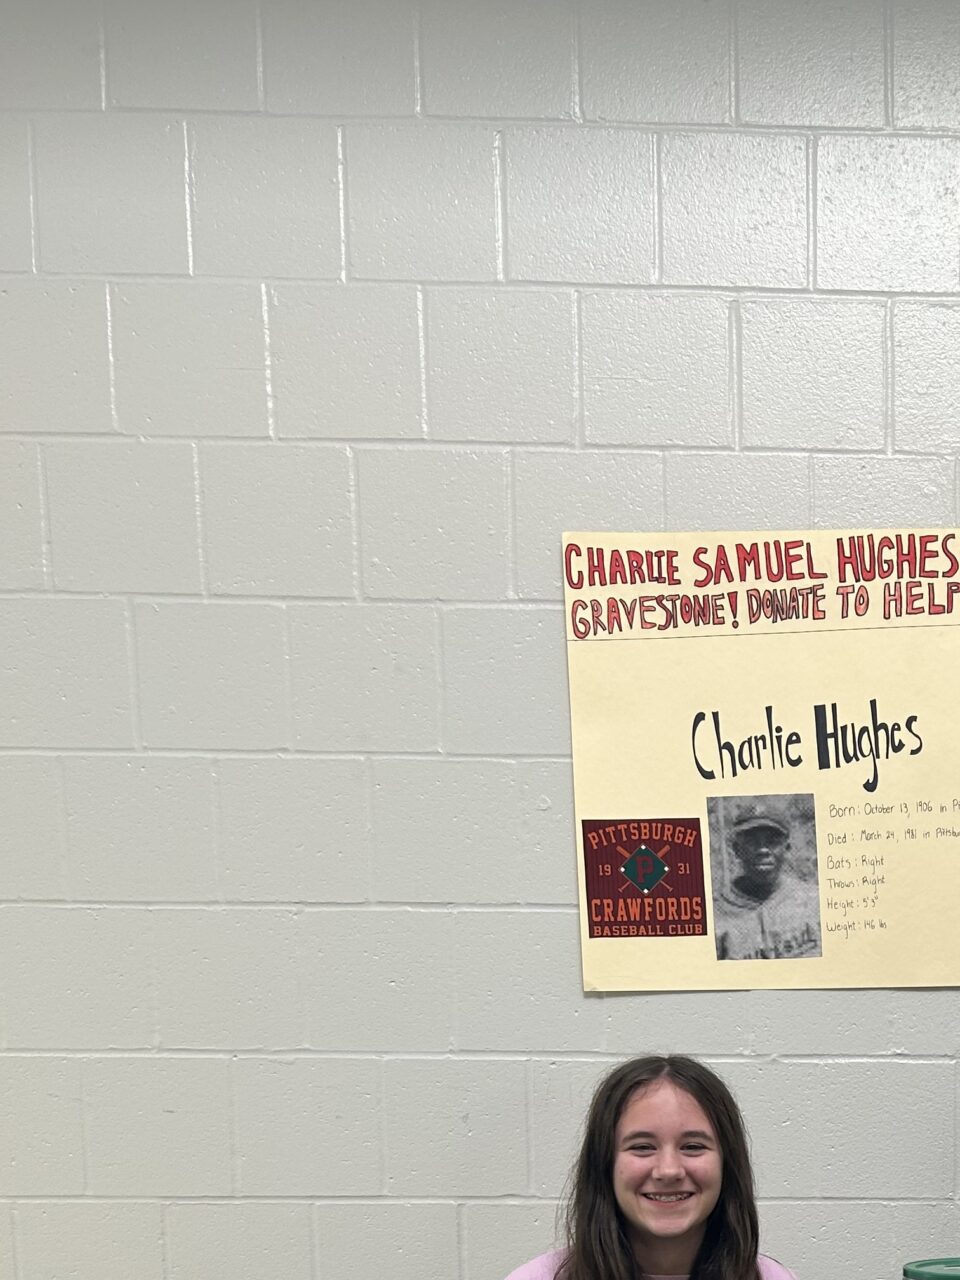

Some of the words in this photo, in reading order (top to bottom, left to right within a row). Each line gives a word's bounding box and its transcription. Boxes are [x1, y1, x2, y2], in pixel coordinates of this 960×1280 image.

[565, 543, 681, 589] CHARLIE
[694, 540, 828, 587] SAMUEL
[836, 534, 960, 583] HUGHES
[571, 591, 739, 639] GRAVESTONE!
[746, 584, 826, 624] DONATE
[836, 585, 870, 618] TO
[692, 705, 803, 780] Charlie
[813, 699, 923, 793] Hughes
[587, 822, 697, 849] PITTSBURGH
[599, 864, 612, 876] 19
[635, 856, 654, 883] P
[678, 863, 690, 874] 31
[591, 897, 702, 921] CRAWFORDS
[594, 925, 663, 936] BASEBALL
[669, 924, 703, 935] CLUB
